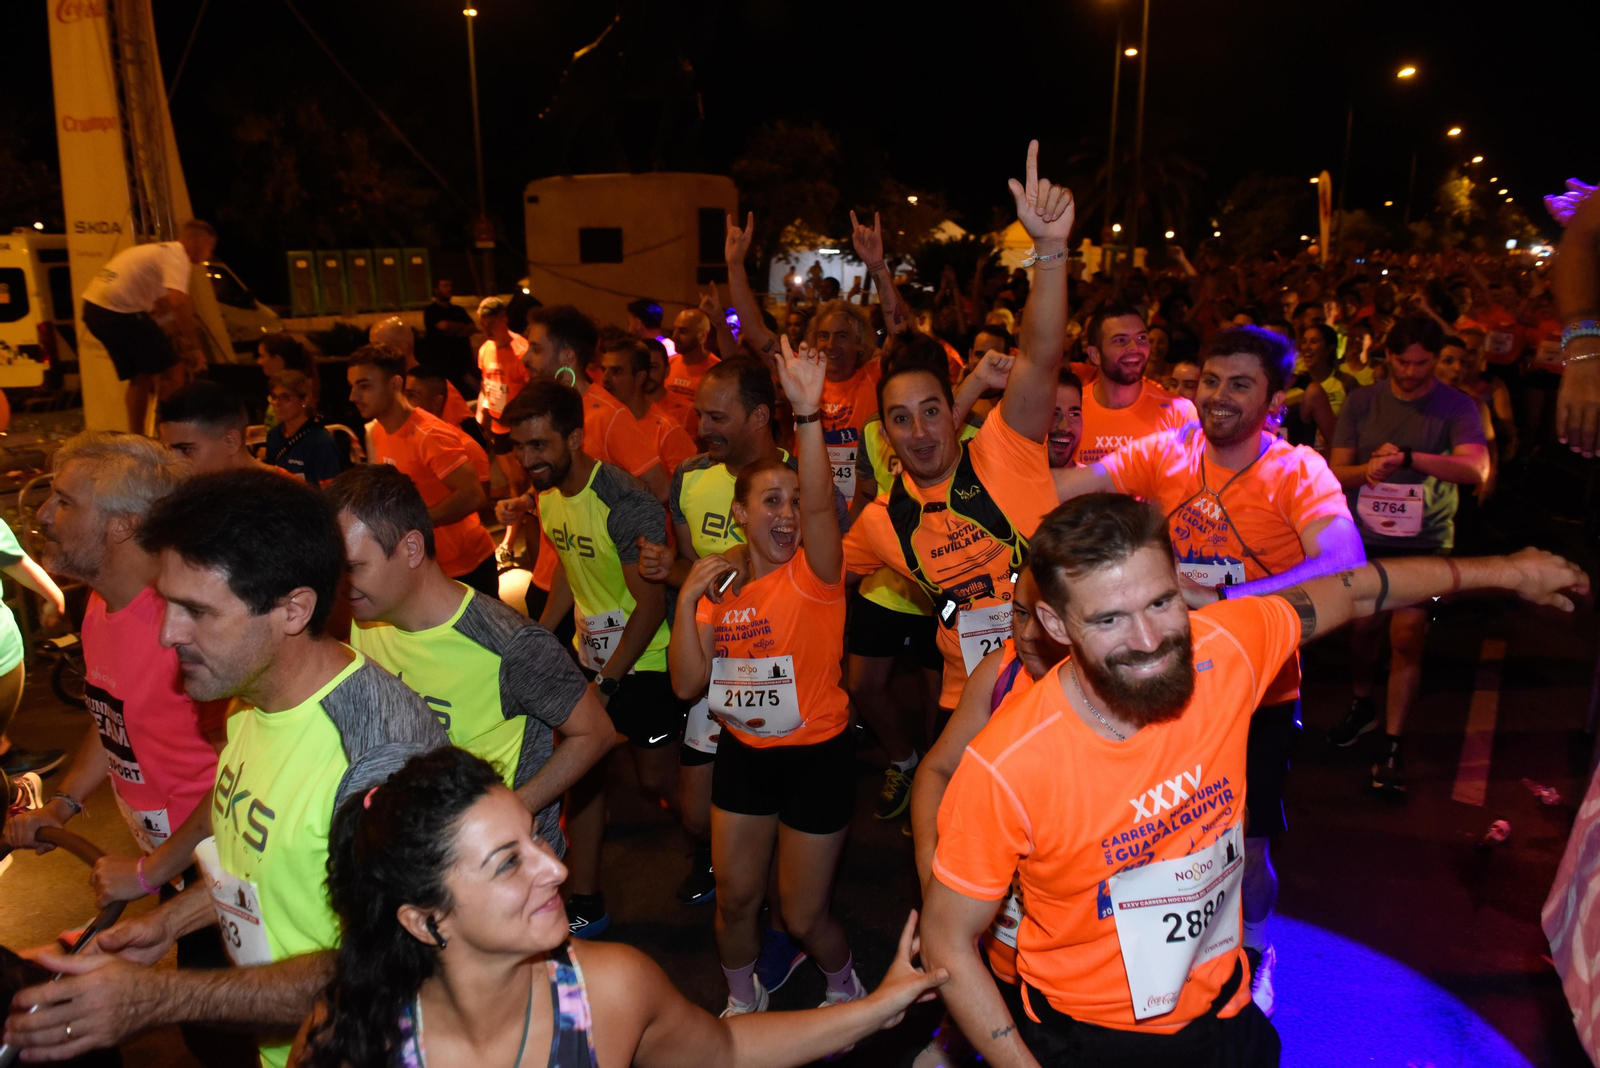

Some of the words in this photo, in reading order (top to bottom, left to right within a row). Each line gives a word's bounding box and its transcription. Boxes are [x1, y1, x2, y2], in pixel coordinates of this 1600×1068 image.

[1193, 498, 1227, 521] XXX
[1372, 501, 1406, 513] 8764
[723, 690, 780, 707] 21275
[1129, 764, 1201, 824] XXXV
[214, 762, 276, 853] eks
[1101, 819, 1167, 849] CARRERA
[1169, 776, 1230, 820] NOCTURNA
[1103, 849, 1115, 866] DEL
[1115, 788, 1234, 862] GUADALQUIVIR
[1102, 908, 1113, 918] 20
[1122, 901, 1139, 909] XXXV
[1140, 897, 1167, 907] CARRERA
